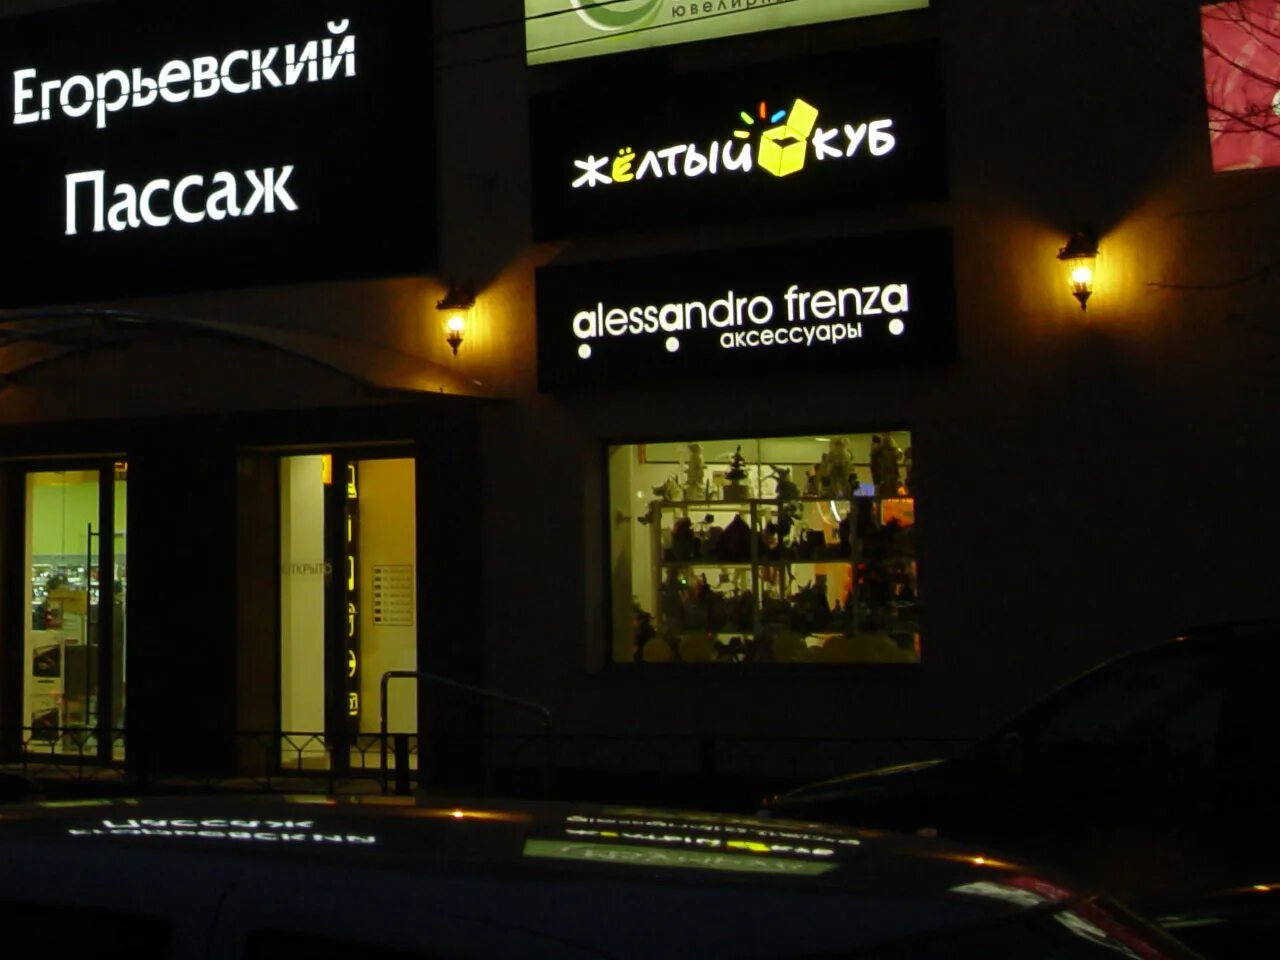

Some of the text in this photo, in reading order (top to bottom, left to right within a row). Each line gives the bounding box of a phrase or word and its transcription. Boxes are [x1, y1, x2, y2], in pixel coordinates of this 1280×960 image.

[13, 18, 356, 129] Егорьевский
[64, 165, 299, 235] Пассаж
[573, 283, 909, 339] alessandro frenza
[720, 322, 862, 348] аксессуары
